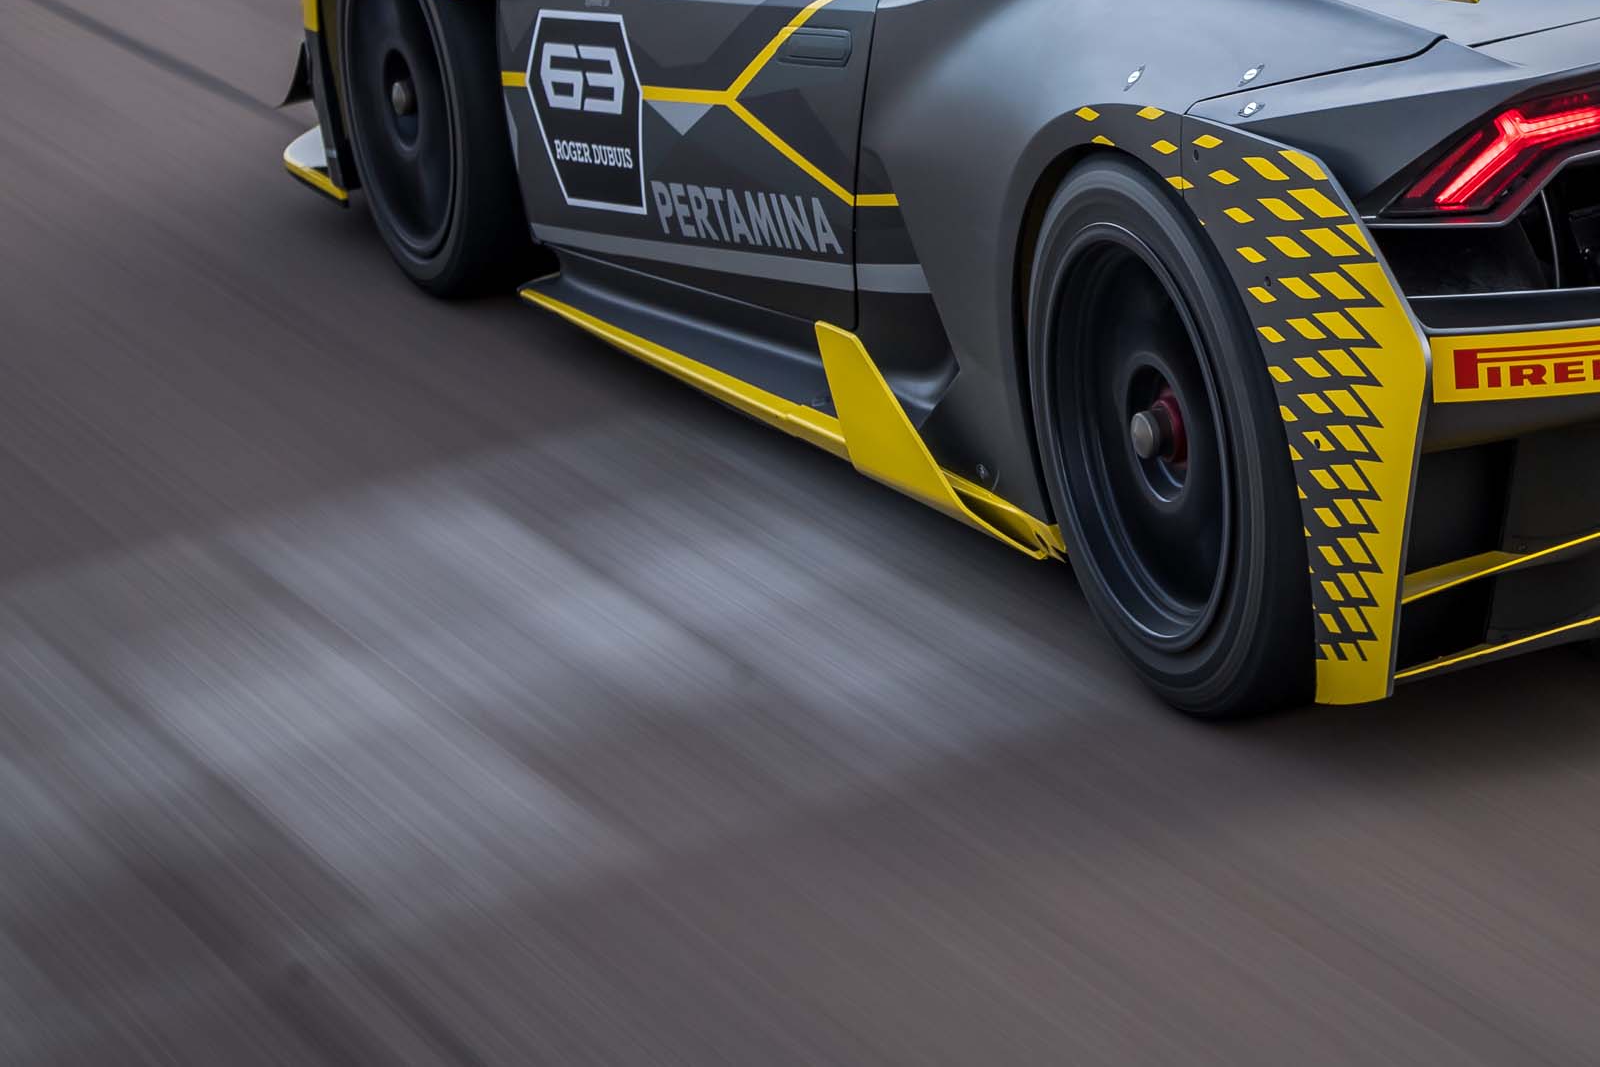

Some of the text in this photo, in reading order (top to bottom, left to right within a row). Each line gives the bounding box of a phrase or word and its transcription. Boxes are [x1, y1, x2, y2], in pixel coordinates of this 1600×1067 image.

[540, 41, 625, 115] 63
[554, 138, 634, 170] ROGER DUBUIS
[650, 179, 845, 255] PERTAMINA
